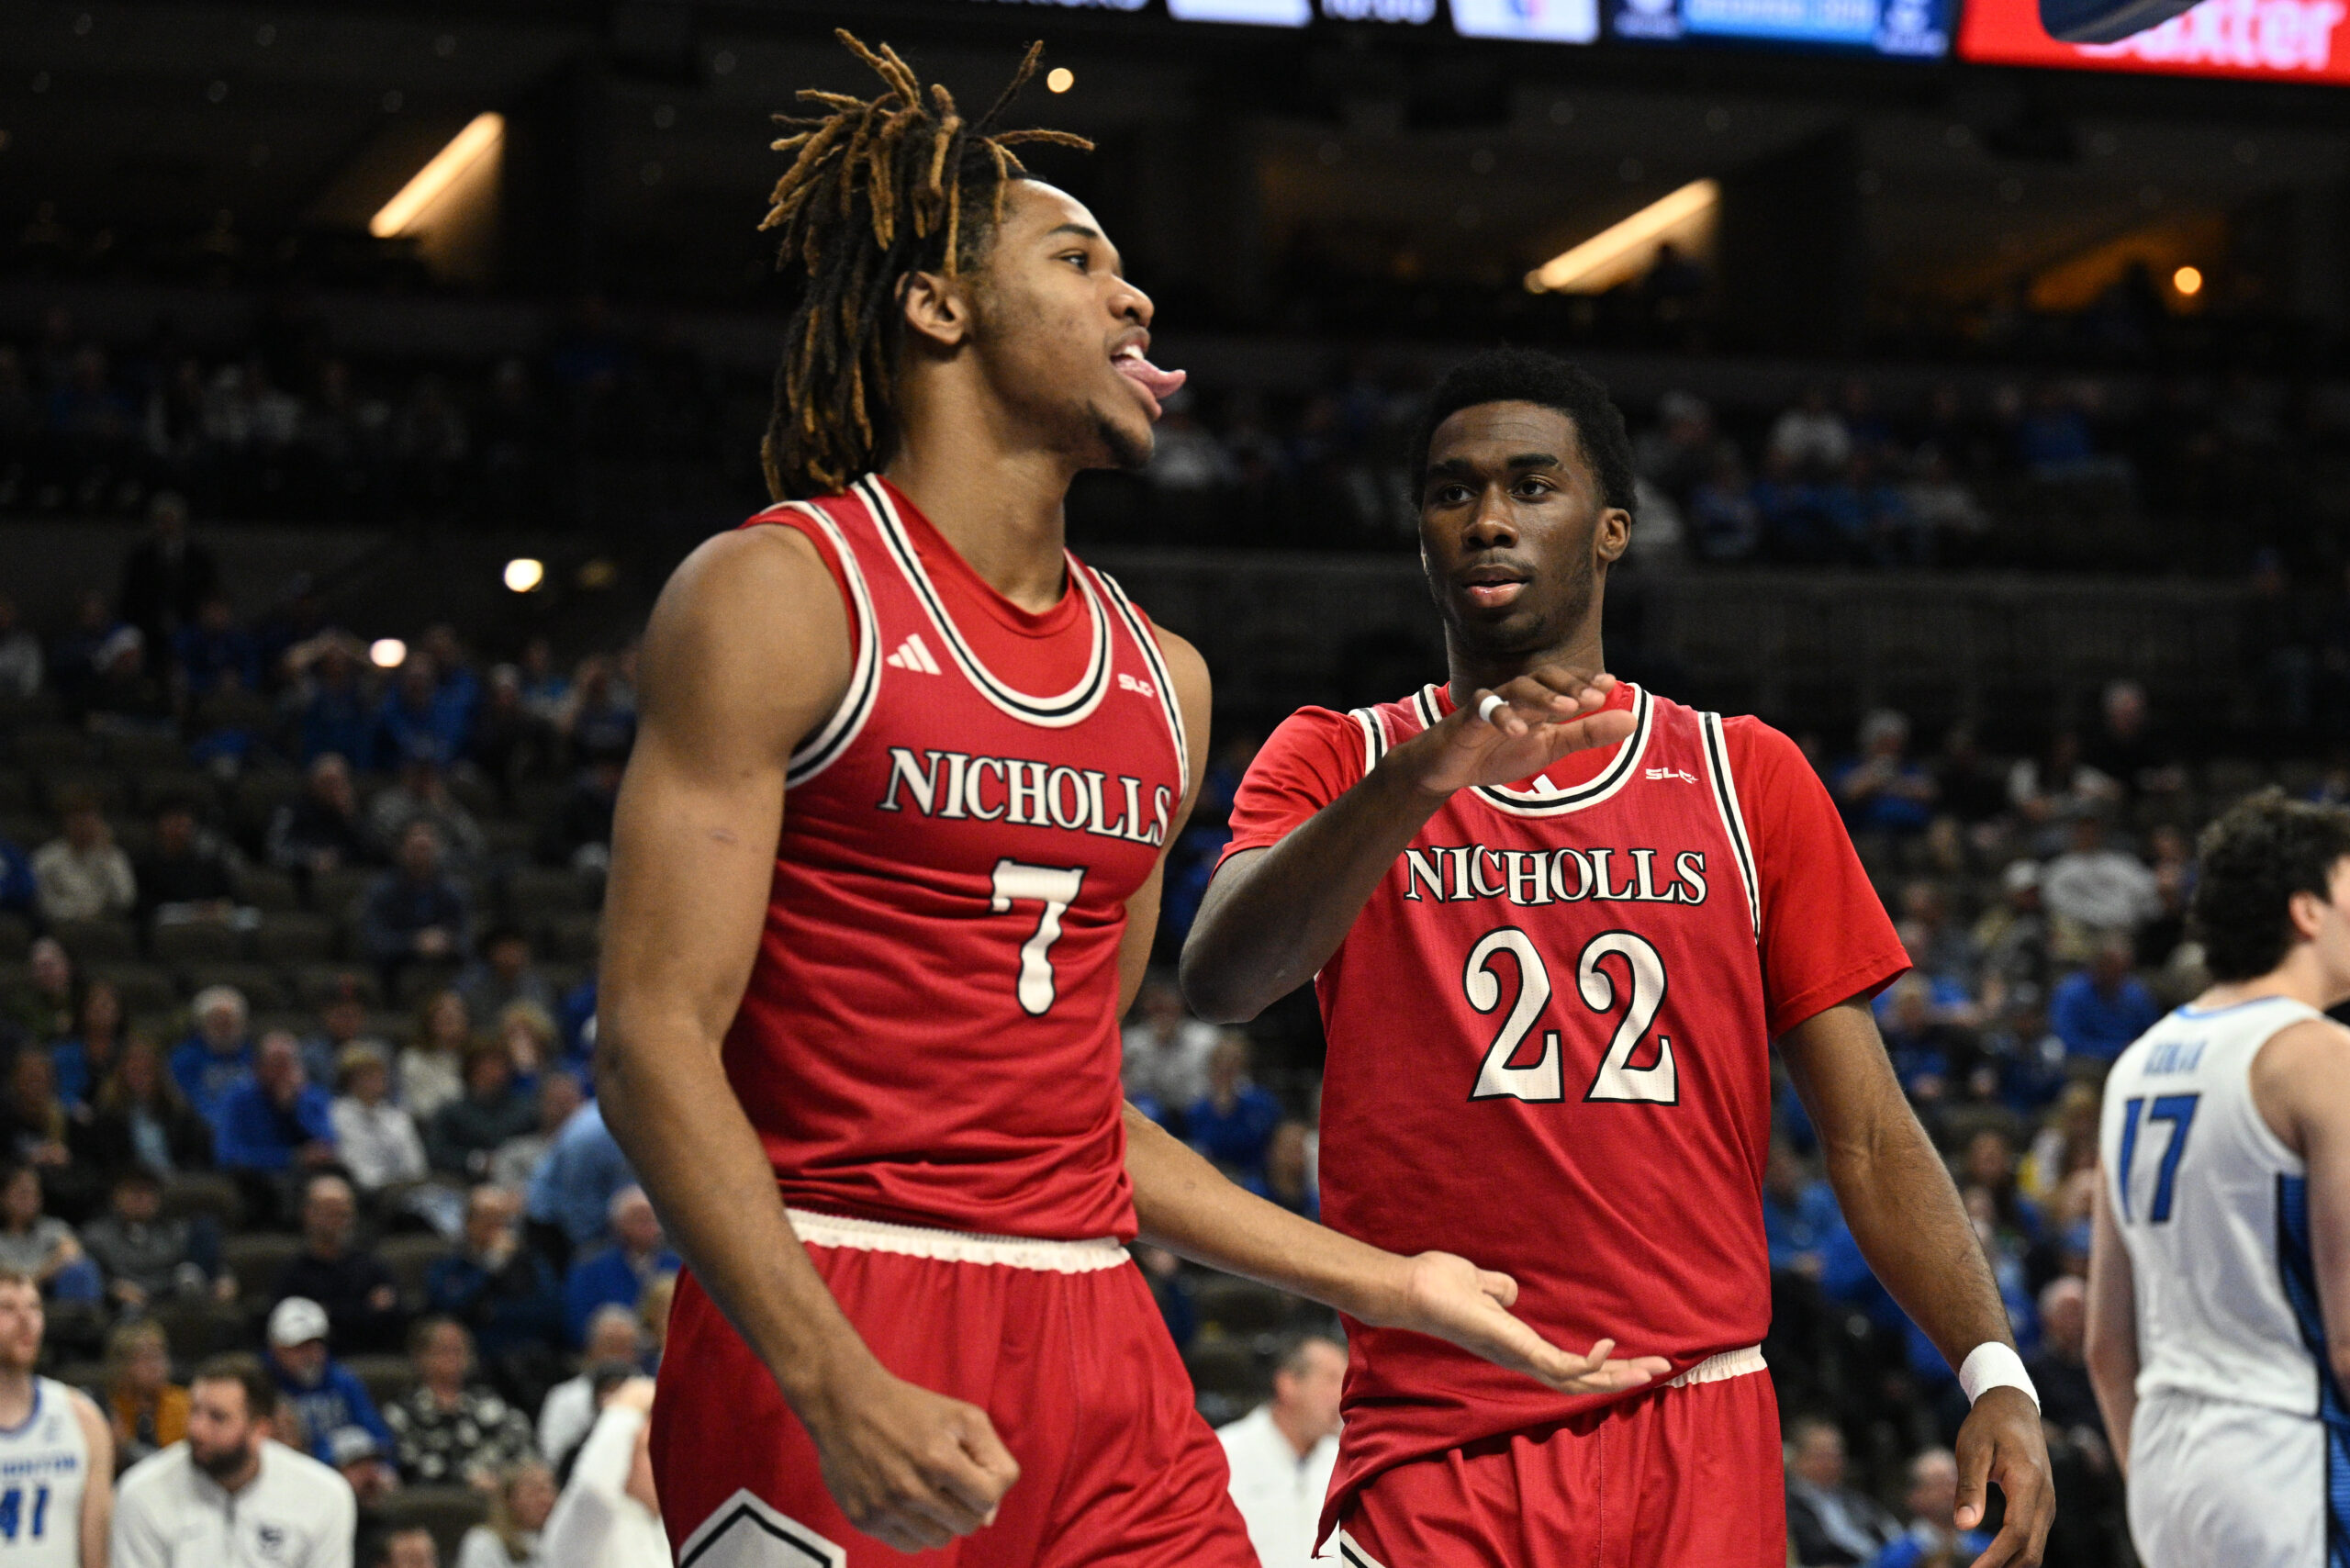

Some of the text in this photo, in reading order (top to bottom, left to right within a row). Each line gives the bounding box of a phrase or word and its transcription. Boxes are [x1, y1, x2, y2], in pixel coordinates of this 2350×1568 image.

[877, 746, 1170, 847] NICHOLLS
[987, 857, 1089, 1016] 7
[1404, 843, 1708, 907] NICHOLLS
[1461, 924, 1680, 1106] 22
[2119, 1091, 2202, 1225] 17
